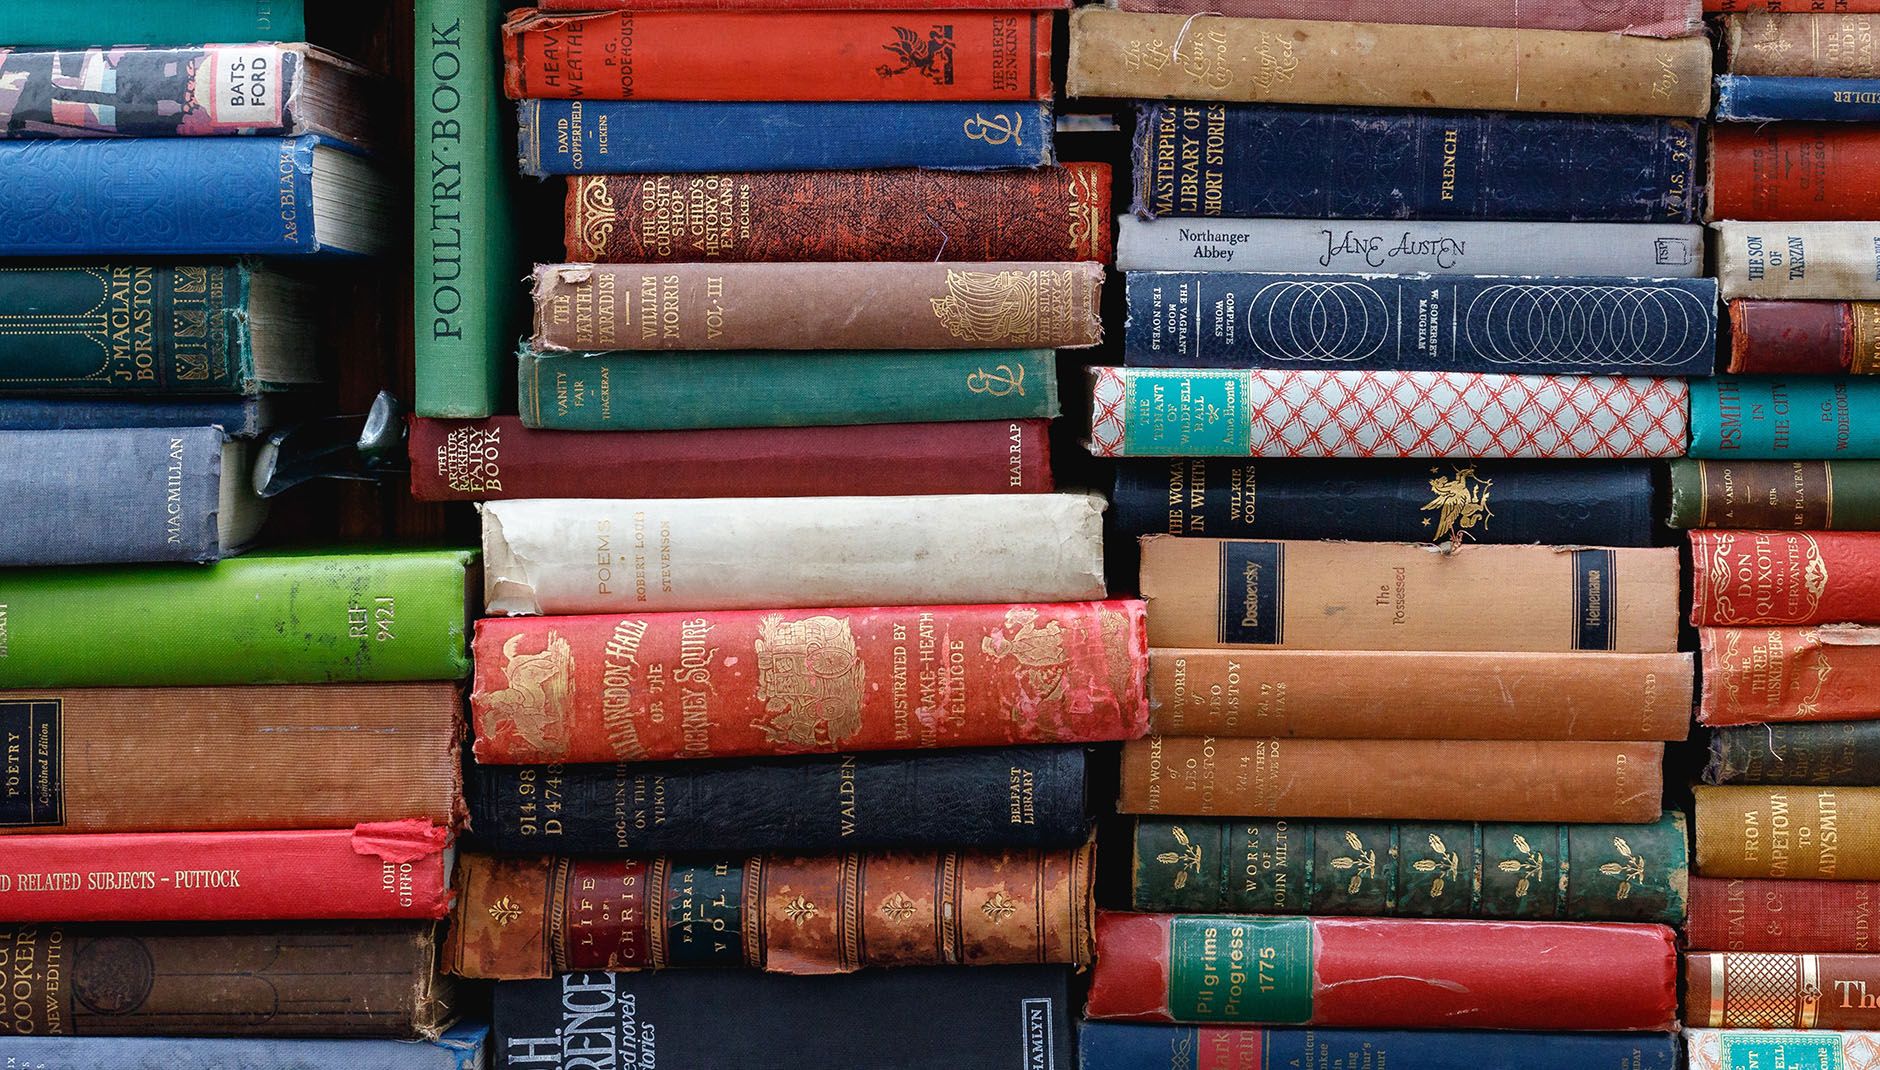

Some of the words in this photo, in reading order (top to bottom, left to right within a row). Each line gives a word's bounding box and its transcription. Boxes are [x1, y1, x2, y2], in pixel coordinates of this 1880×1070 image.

[566, 21, 584, 98] WEATHE
[620, 10, 635, 98] WODEHOUSE
[992, 16, 1004, 91] HERBERT
[1005, 16, 1018, 92] JENKINS
[1142, 37, 1164, 78] Life
[230, 57, 246, 107] BATS-
[250, 57, 267, 107] FORD
[558, 118, 569, 154] DAVID
[572, 100, 583, 170] COPPERFIELD
[599, 114, 609, 155] DICKENS
[1182, 105, 1201, 131] OF
[1206, 103, 1226, 167] STORIES
[1180, 137, 1200, 213] LIBRARY
[1441, 129, 1459, 202] FRENCH
[642, 180, 656, 212] OLD
[672, 190, 684, 237] SHOP
[721, 177, 734, 250] ENGLAND
[741, 183, 750, 240] DICKENS
[1204, 171, 1224, 217] SHORT
[642, 216, 656, 247] THE
[692, 239, 704, 252] A
[706, 196, 719, 256] HISTORY
[1179, 228, 1250, 247] Northanger
[1747, 236, 1764, 261] SON
[1193, 244, 1235, 263] Abbey
[1748, 261, 1765, 282] THE
[1769, 250, 1783, 267] OF
[1787, 235, 1807, 281] TARZAN
[554, 294, 570, 325] THE
[599, 272, 616, 344] PARADISE
[641, 274, 657, 340] WILLIAM
[663, 274, 679, 339] MORRIS
[706, 276, 723, 298] III
[1039, 269, 1050, 313] SILVER
[1152, 286, 1162, 308] TEN
[1179, 283, 1189, 299] THE
[135, 266, 154, 381] BORASTON
[1151, 309, 1162, 352] NOVELS
[1168, 303, 1177, 334] MOOD
[1177, 299, 1188, 355] VAGRANT
[1214, 300, 1224, 338] WORKS
[1225, 292, 1235, 346] COMPLETE
[1417, 299, 1428, 351] MAUGHAM
[1429, 303, 1440, 359] SOMERSET
[558, 371, 568, 418] VANITY
[574, 379, 585, 408] FAIR
[601, 364, 611, 421] THACKERAY
[1139, 397, 1151, 426] THE
[1152, 383, 1165, 441] TENANT
[1167, 403, 1178, 422] OF
[1194, 395, 1206, 432] HALL
[1718, 380, 1742, 451] PSMITH
[1751, 402, 1765, 422] IN
[1009, 422, 1022, 488] HARRAP
[1222, 418, 1236, 444] Anne
[1773, 419, 1790, 452] THE
[437, 444, 448, 476] THE
[448, 430, 460, 492] ARTHUR
[458, 426, 470, 493] RACKHAM
[469, 426, 485, 493] FAIRY
[486, 426, 502, 492] BOOK
[168, 438, 185, 544] MACMILLAN
[1230, 467, 1243, 521] WILKIE
[1244, 464, 1257, 525] COLLINS
[1725, 468, 1734, 506] VANLOO
[1769, 487, 1778, 507] SUR
[1168, 509, 1184, 536] THE
[1190, 515, 1205, 533] IN
[597, 518, 612, 596] POEMS
[635, 555, 647, 602] ROBERT
[660, 520, 673, 593] STEVENSON
[1738, 553, 1753, 599] DON
[1755, 534, 1775, 617] QUIXOTE
[1787, 536, 1799, 616] CERVANTES
[1240, 560, 1263, 628] Dostoevsky
[1375, 584, 1390, 606] The
[1391, 566, 1406, 625] Possessed
[1584, 568, 1601, 629] Heinemann
[349, 602, 368, 638] REF
[604, 618, 650, 668] HALL
[894, 622, 906, 641] BY
[648, 663, 665, 695] THE
[673, 617, 718, 696] SQUIRE
[1742, 656, 1751, 683] THE
[1752, 644, 1768, 695] THREE
[894, 645, 911, 740] ILLUSTRATED
[1172, 658, 1187, 708] WORKS
[1190, 692, 1206, 706] of
[1209, 683, 1223, 715] LEO
[649, 701, 665, 724] OR
[8, 731, 20, 798] POETRY
[38, 722, 50, 763] Edition
[841, 755, 856, 837] WALDEN
[1011, 766, 1021, 824] BELFAST
[1023, 768, 1034, 825] LIBRARY
[1166, 766, 1181, 780] of
[1184, 757, 1198, 791] LEO
[519, 769, 537, 836] 914.98
[634, 810, 646, 829] ON
[655, 775, 666, 825] YUKON
[545, 819, 562, 836] D
[1744, 810, 1760, 863] FROM
[1799, 826, 1812, 848] TO
[17, 873, 81, 892] RELATED
[88, 871, 155, 890] SUBJECTS
[174, 869, 241, 889] PUTTOCK
[1246, 826, 1260, 892] WORKS
[1262, 851, 1272, 869] OF
[581, 877, 595, 946] LIFE
[1273, 870, 1287, 908] JOHN
[1224, 926, 1245, 1017] Progress
[1259, 946, 1276, 994] 1775
[618, 991, 637, 1045] novels
